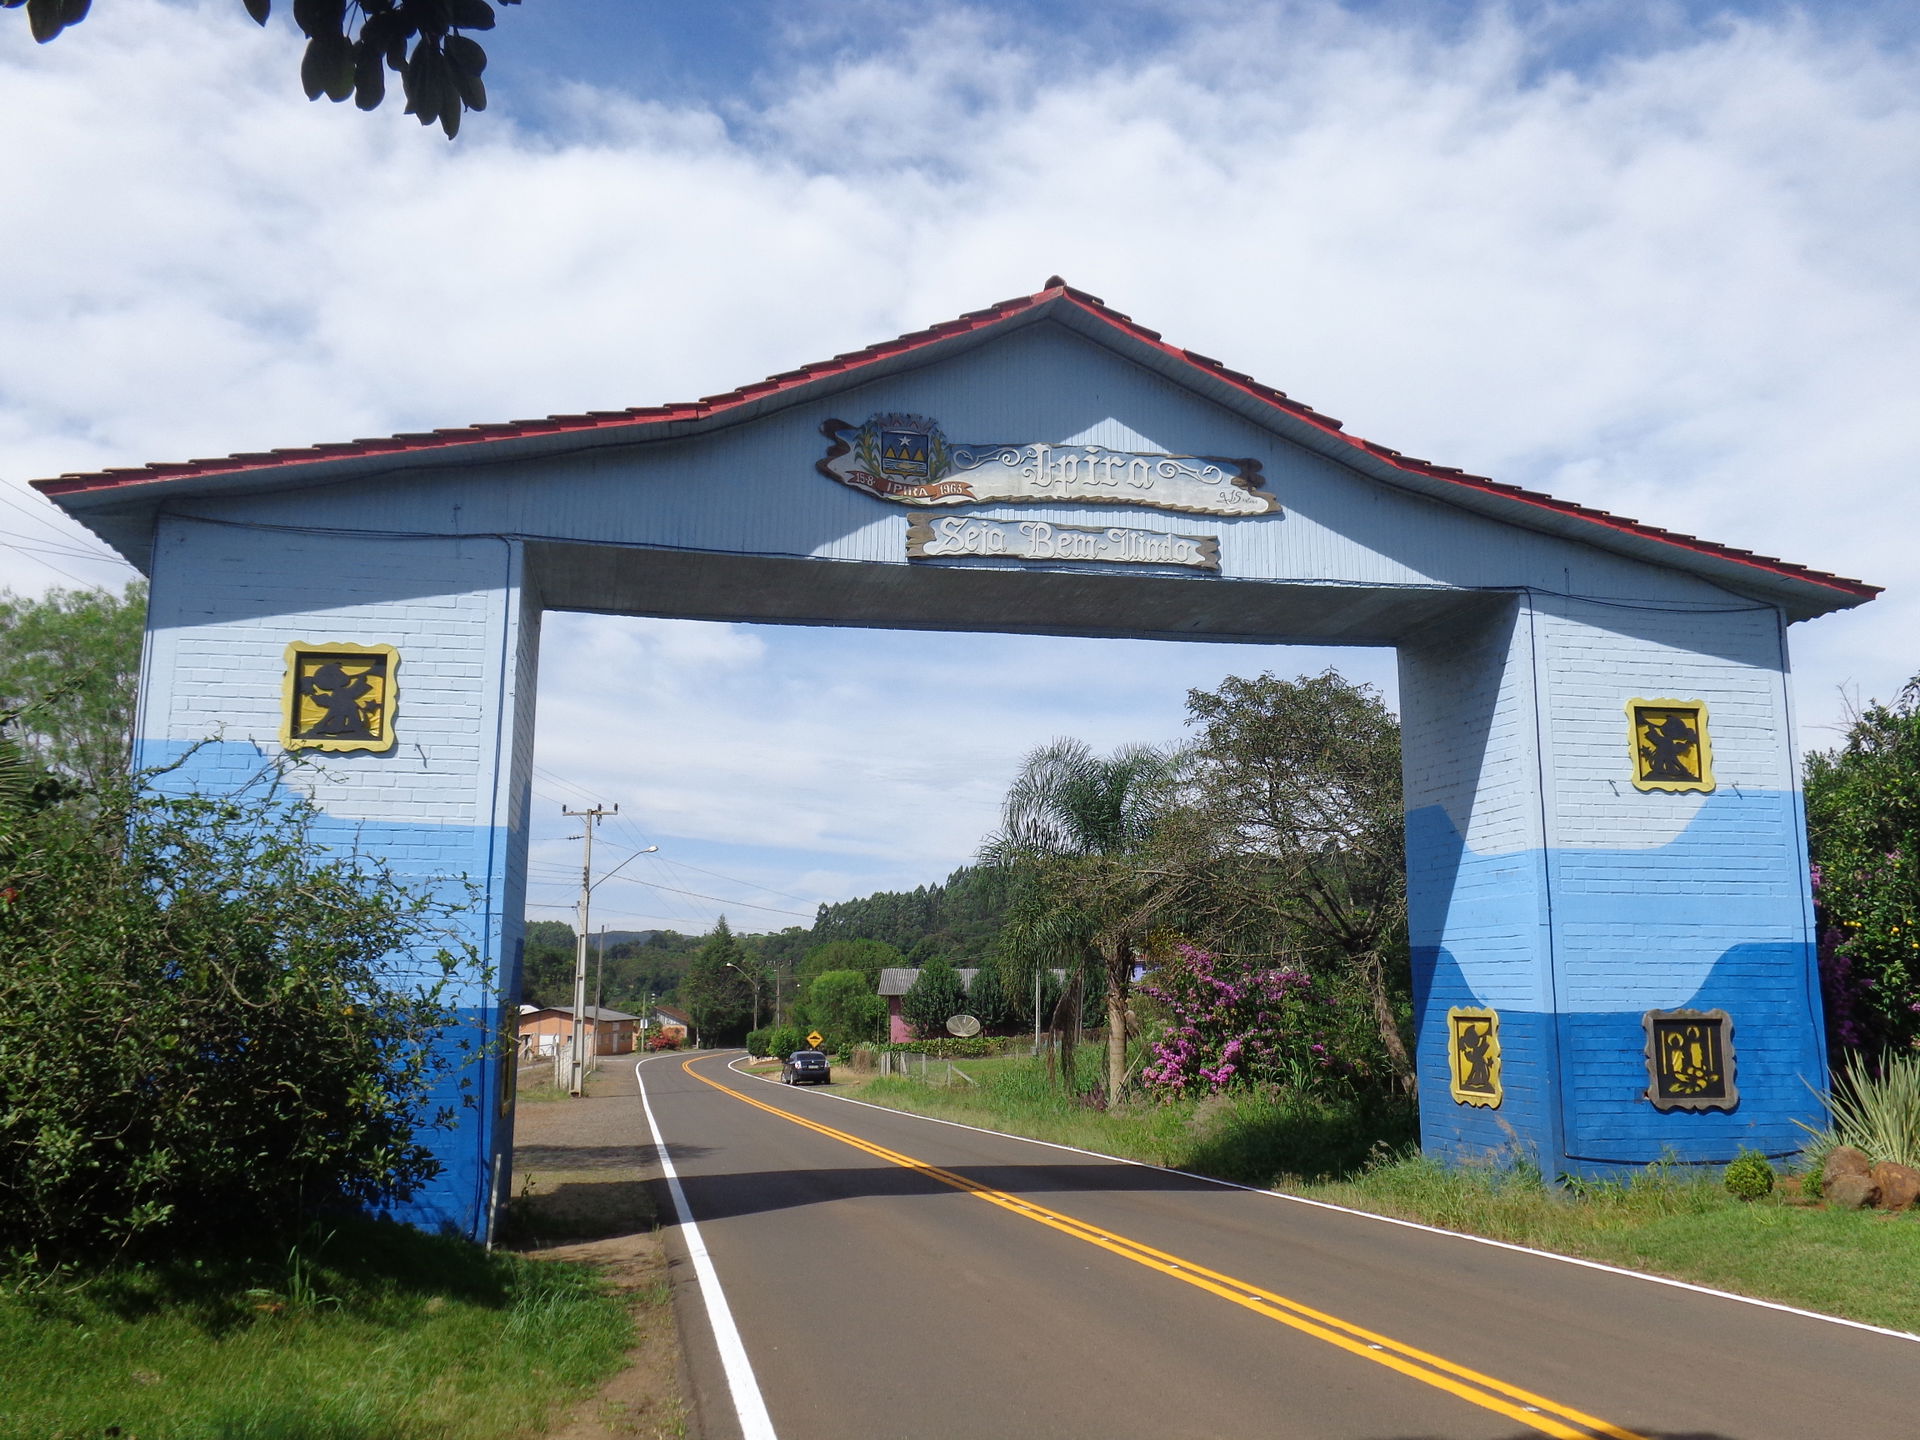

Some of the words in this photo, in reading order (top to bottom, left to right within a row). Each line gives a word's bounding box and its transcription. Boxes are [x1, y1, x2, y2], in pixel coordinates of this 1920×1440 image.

[887, 482, 928, 497] IPIRA
[940, 483, 963, 495] 1963
[1021, 443, 1155, 497] Ipira
[936, 516, 1007, 556] Seja
